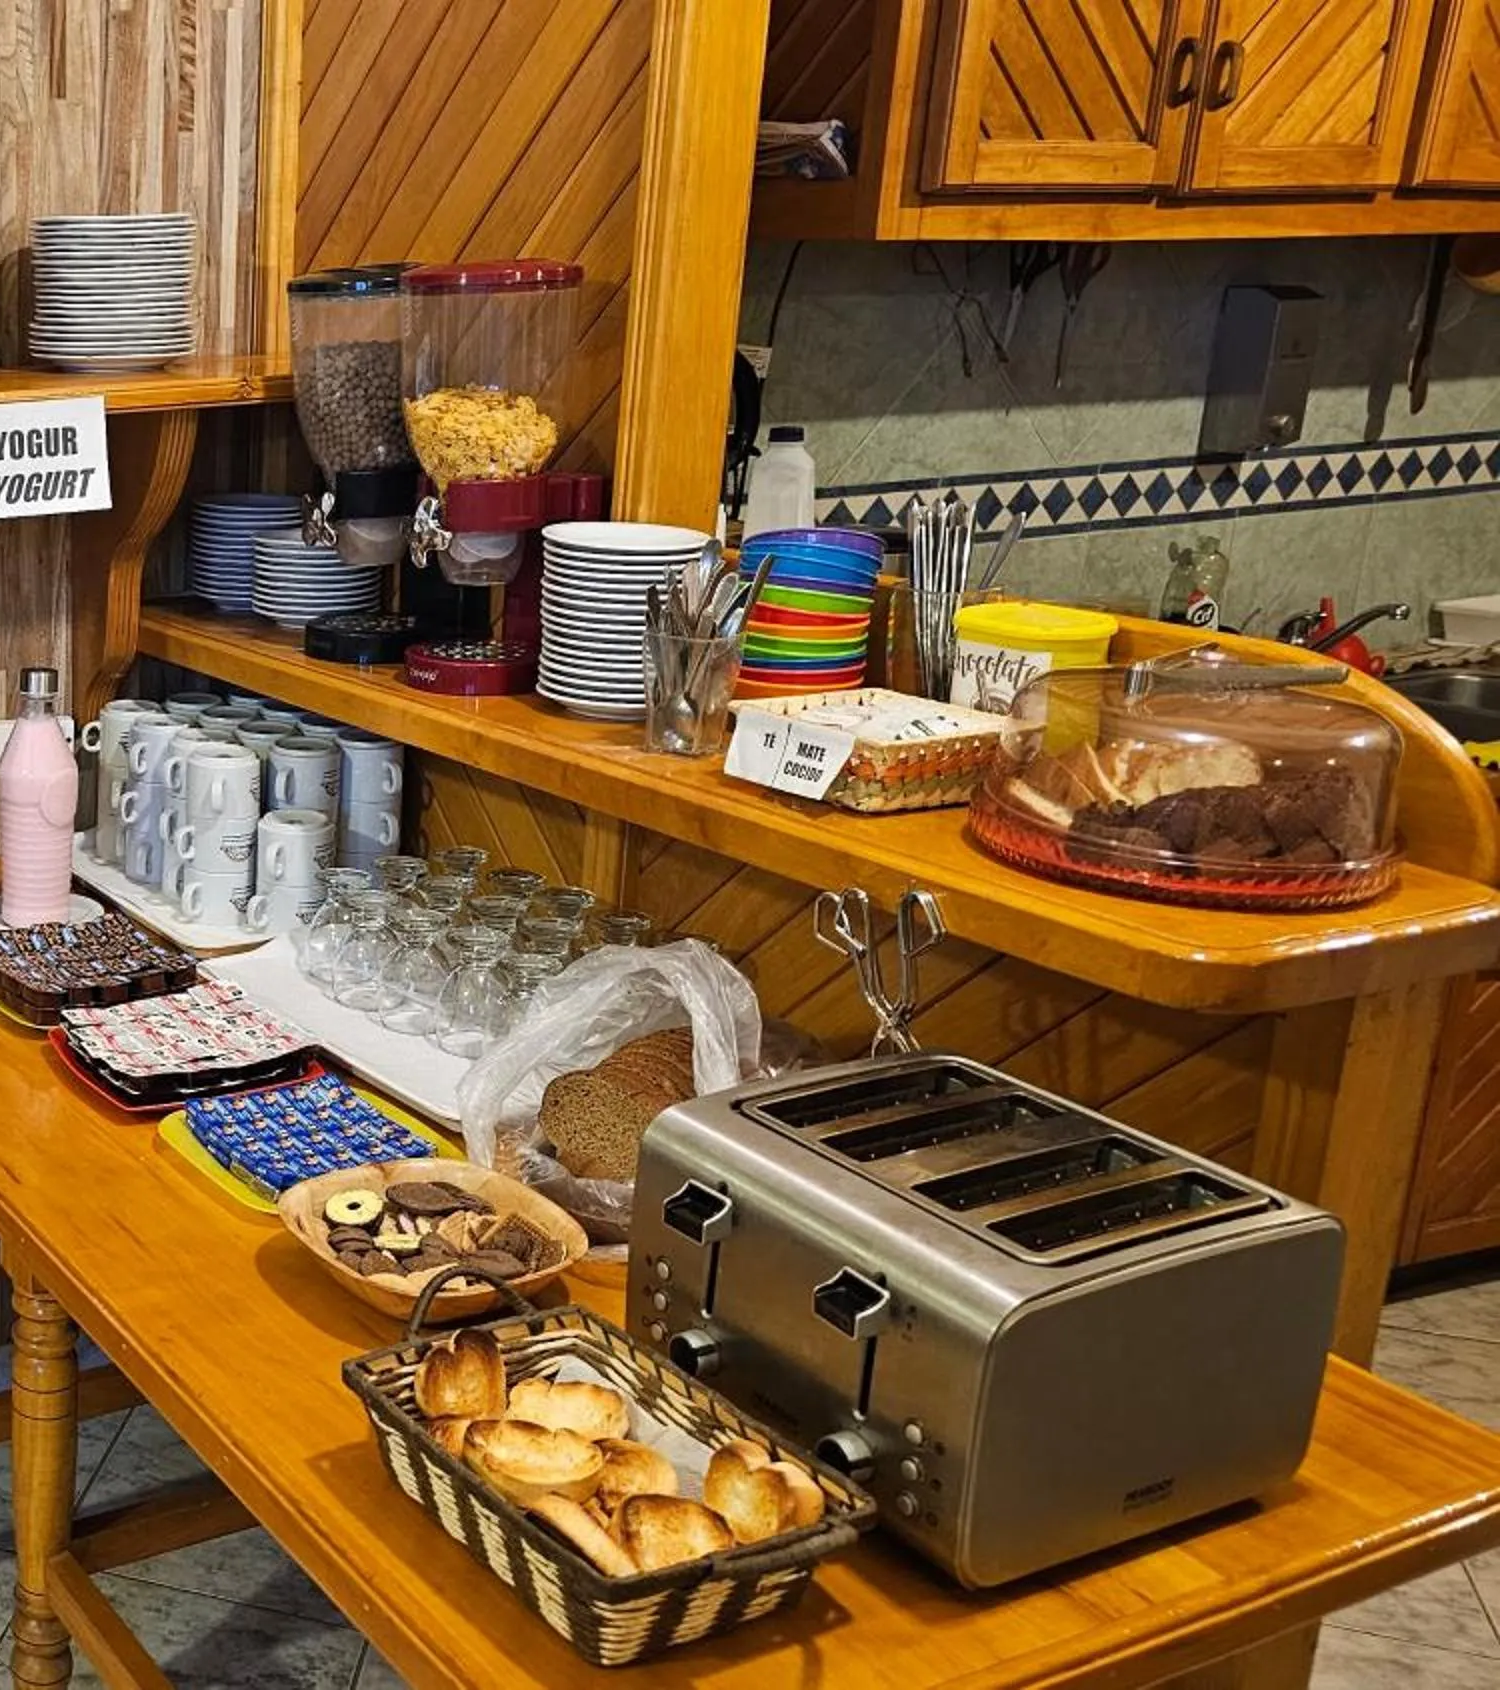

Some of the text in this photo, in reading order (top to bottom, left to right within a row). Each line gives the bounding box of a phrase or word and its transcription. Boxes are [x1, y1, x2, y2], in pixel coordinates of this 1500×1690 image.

[951, 648, 1041, 690] hocolate
[797, 741, 827, 762] MATE
[784, 761, 824, 782] COCIDO
